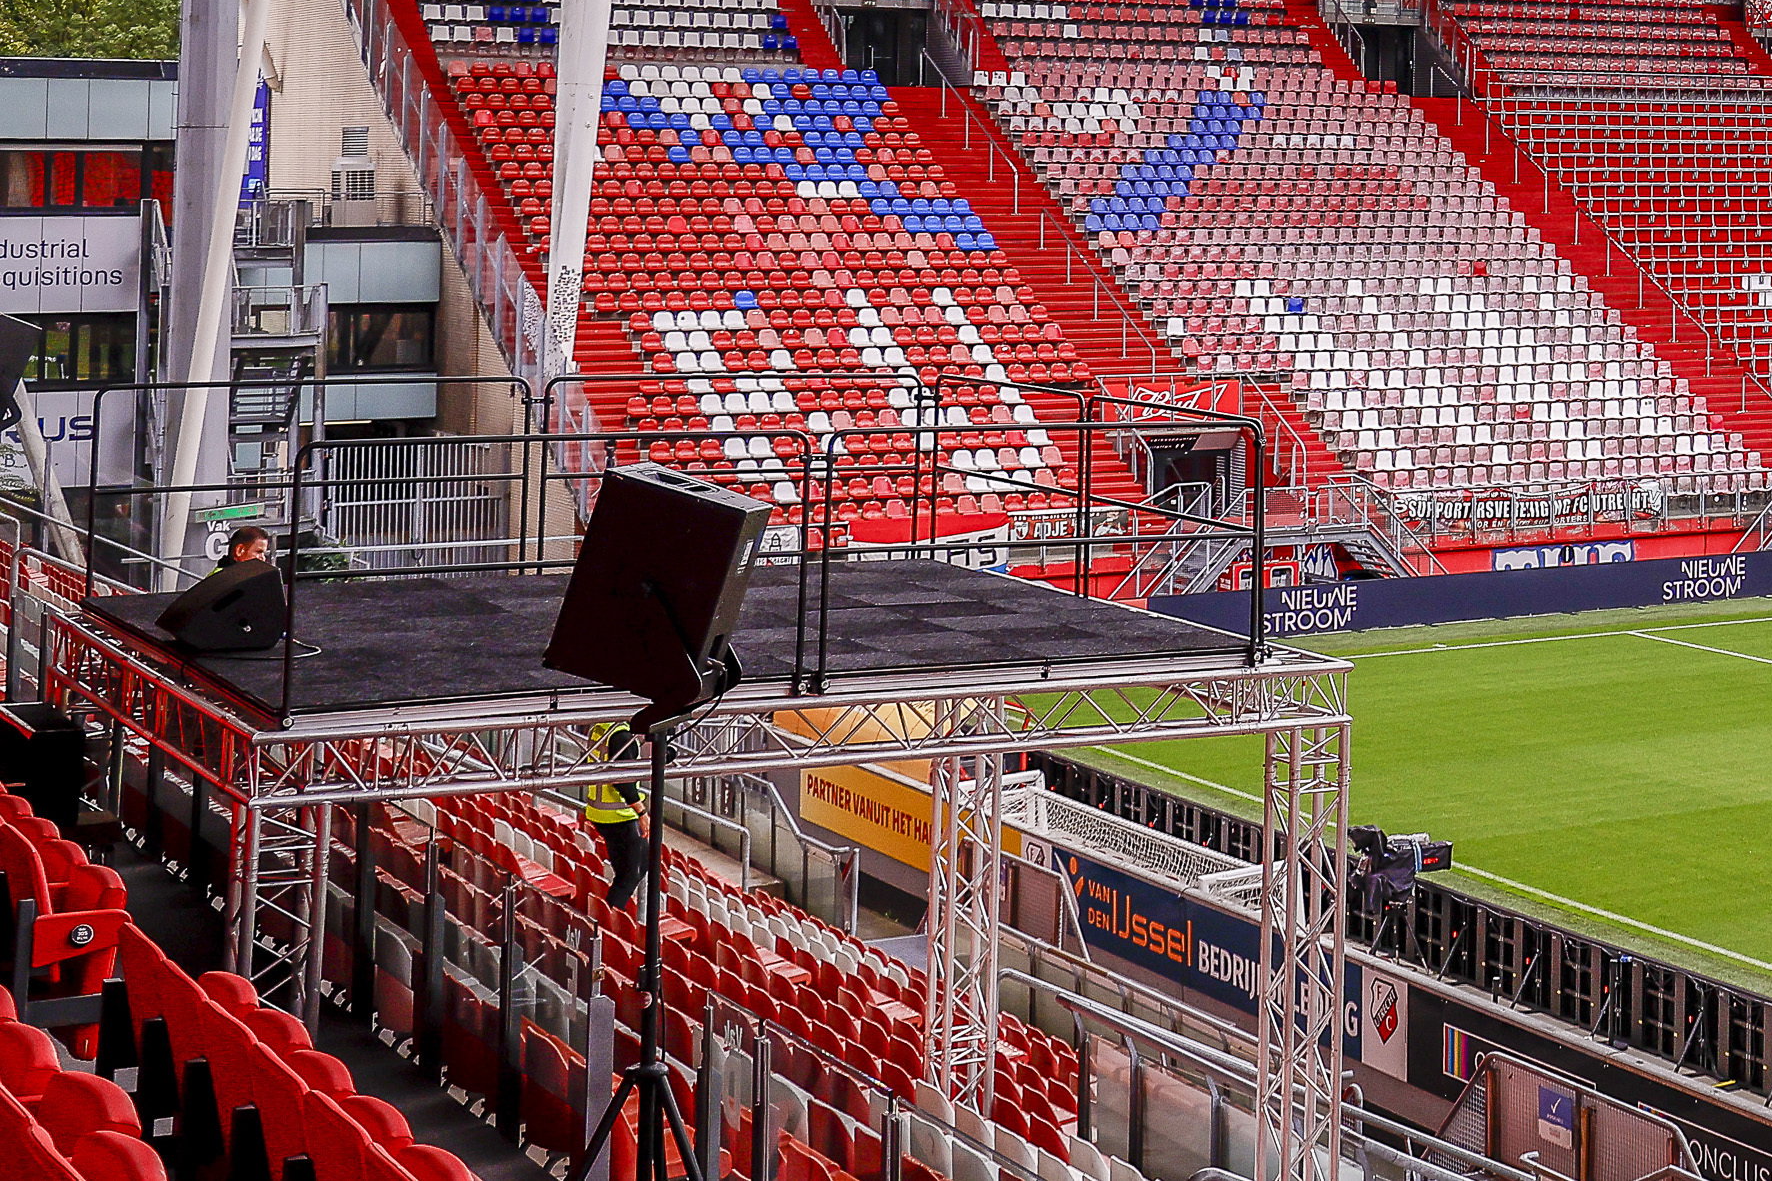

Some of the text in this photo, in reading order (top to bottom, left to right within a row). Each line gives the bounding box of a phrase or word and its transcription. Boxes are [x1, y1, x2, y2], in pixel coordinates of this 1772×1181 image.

[1592, 490, 1650, 512] UTREHT
[206, 520, 231, 532] Vak
[205, 531, 230, 561] G
[1681, 555, 1746, 579] NIEUWE
[1281, 584, 1357, 611] NIEUWE
[1662, 576, 1744, 603] STROOM
[1263, 607, 1353, 634] STROOM
[806, 774, 851, 812] PARTNER
[852, 792, 891, 828] VANUIT
[892, 807, 912, 837] HET
[1088, 879, 1110, 904] VAN
[1087, 907, 1110, 932] DEN
[1373, 988, 1397, 1028] UTRECHT
